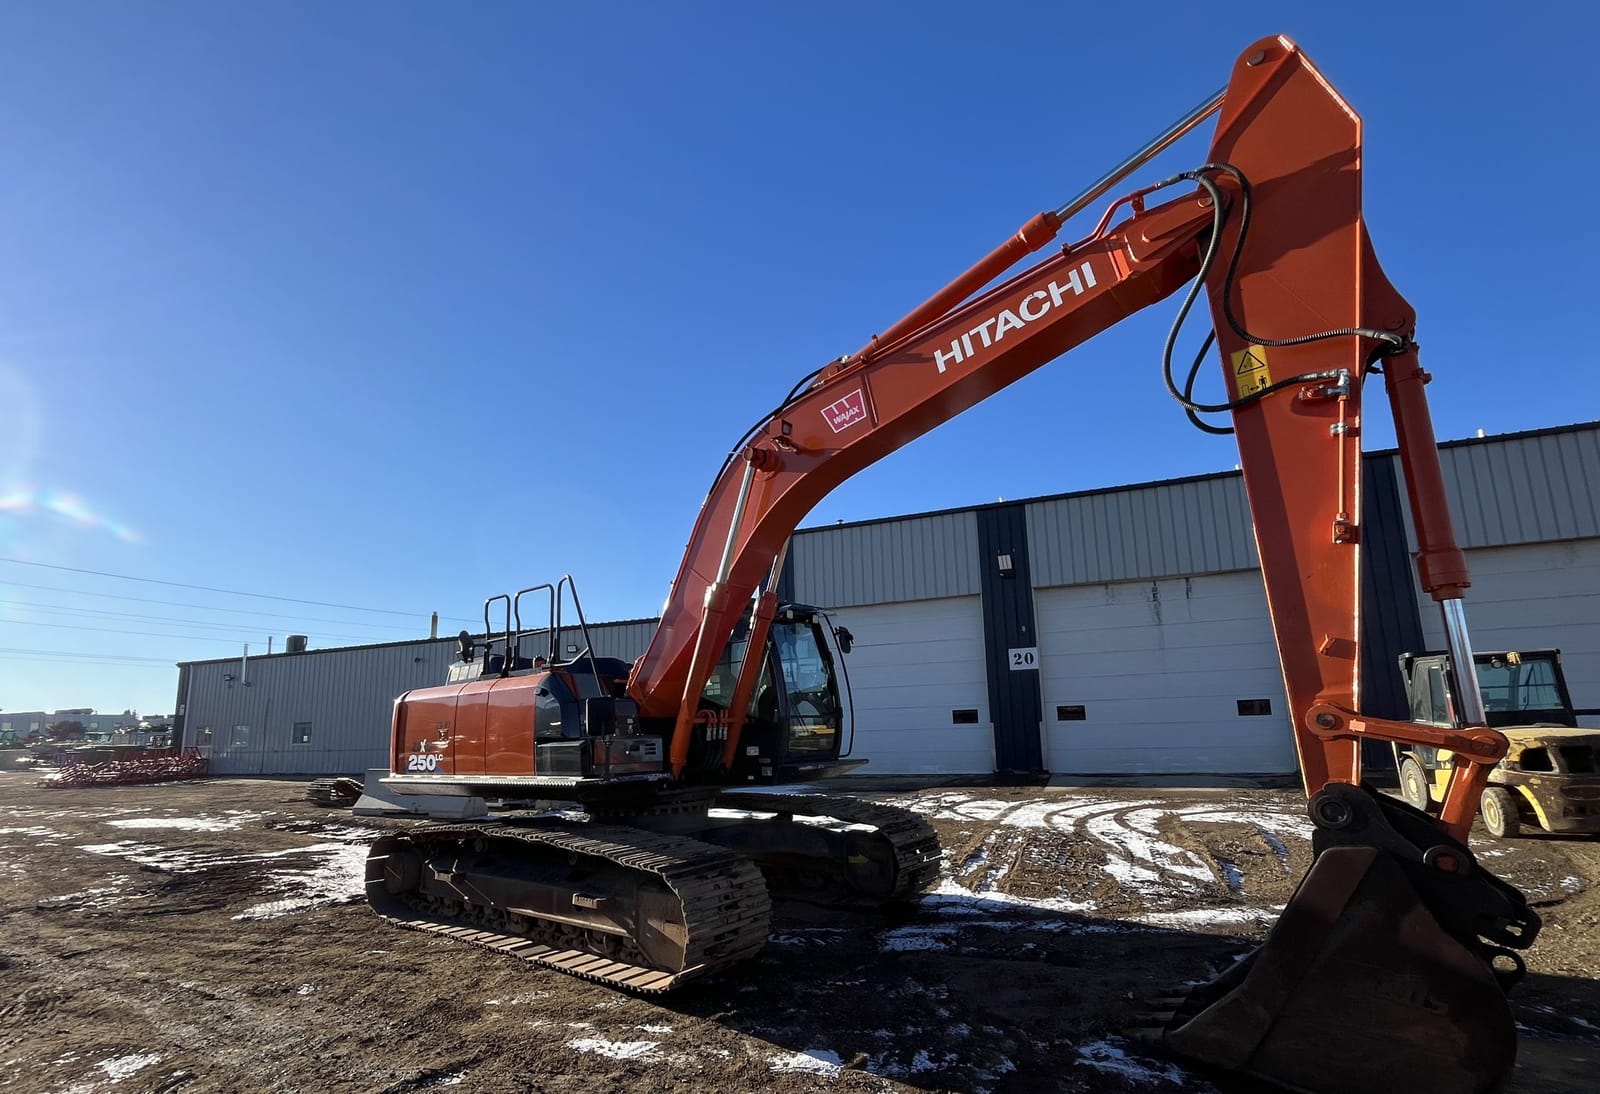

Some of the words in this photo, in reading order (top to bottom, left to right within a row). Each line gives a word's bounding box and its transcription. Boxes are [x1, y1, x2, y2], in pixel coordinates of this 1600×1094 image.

[933, 261, 1097, 374] HITACHI
[833, 405, 860, 425] WAJAX
[1013, 652, 1034, 665] 20
